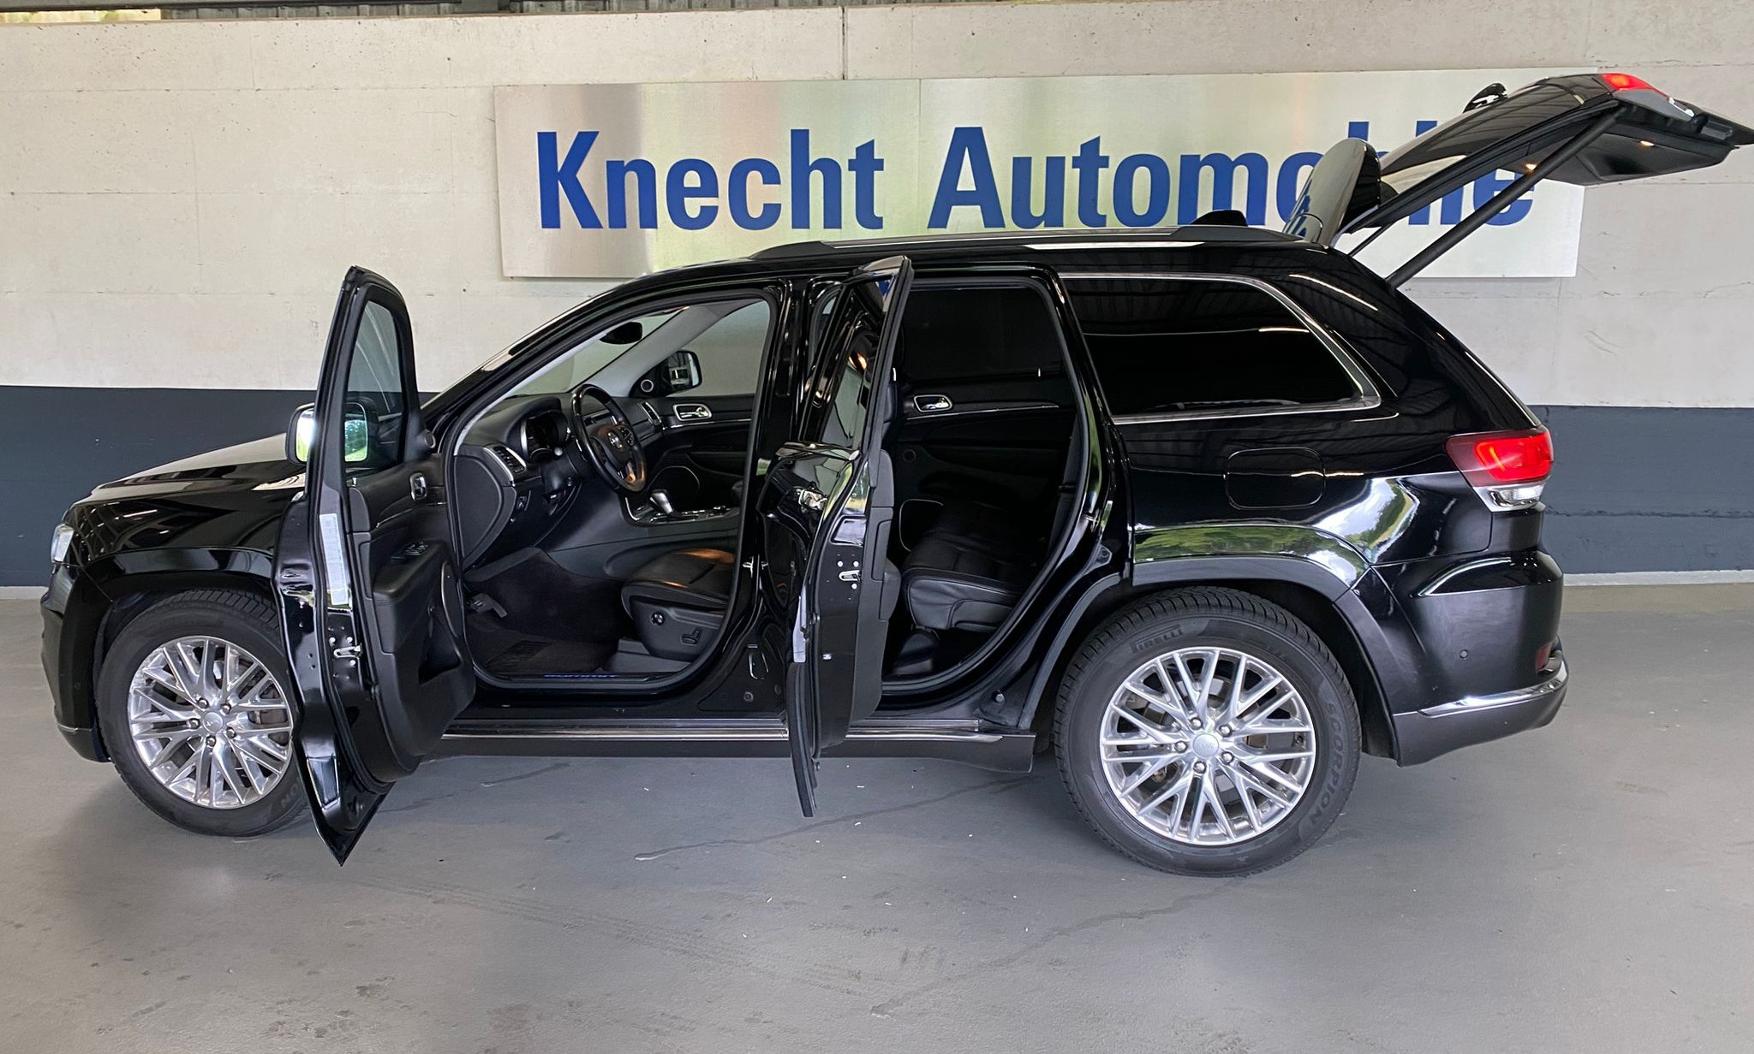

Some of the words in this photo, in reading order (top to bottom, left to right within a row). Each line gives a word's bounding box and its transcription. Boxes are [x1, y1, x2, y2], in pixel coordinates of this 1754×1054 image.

[536, 128, 885, 230] Knecht
[926, 121, 1535, 229] Automoe
[1307, 702, 1345, 825] SCORPION
